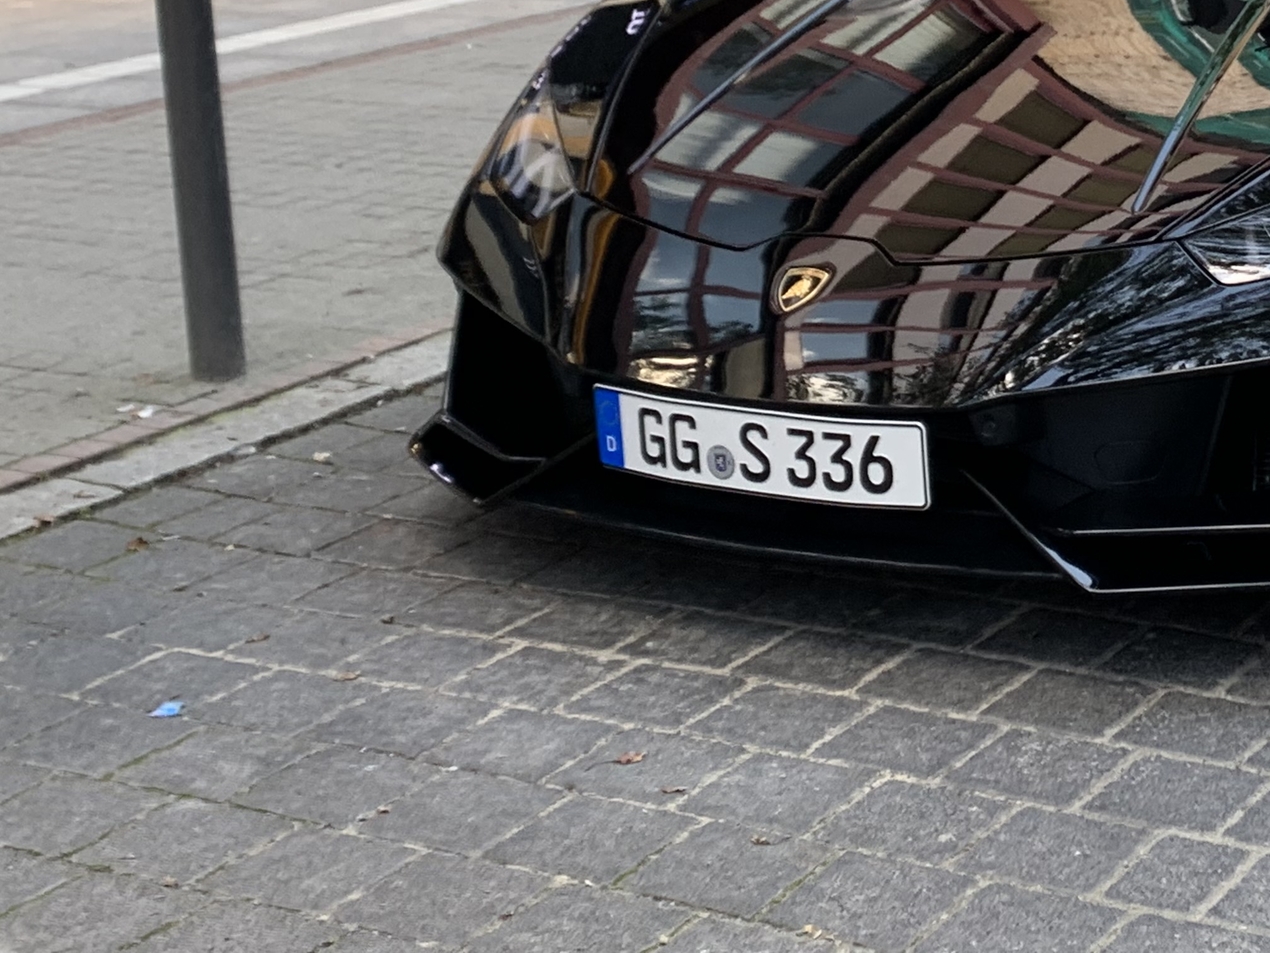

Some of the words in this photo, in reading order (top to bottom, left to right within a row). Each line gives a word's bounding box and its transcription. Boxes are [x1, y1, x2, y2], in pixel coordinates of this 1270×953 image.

[606, 435, 617, 452] D
[638, 407, 700, 474] GG
[738, 422, 771, 483] S
[786, 428, 894, 494] 336
